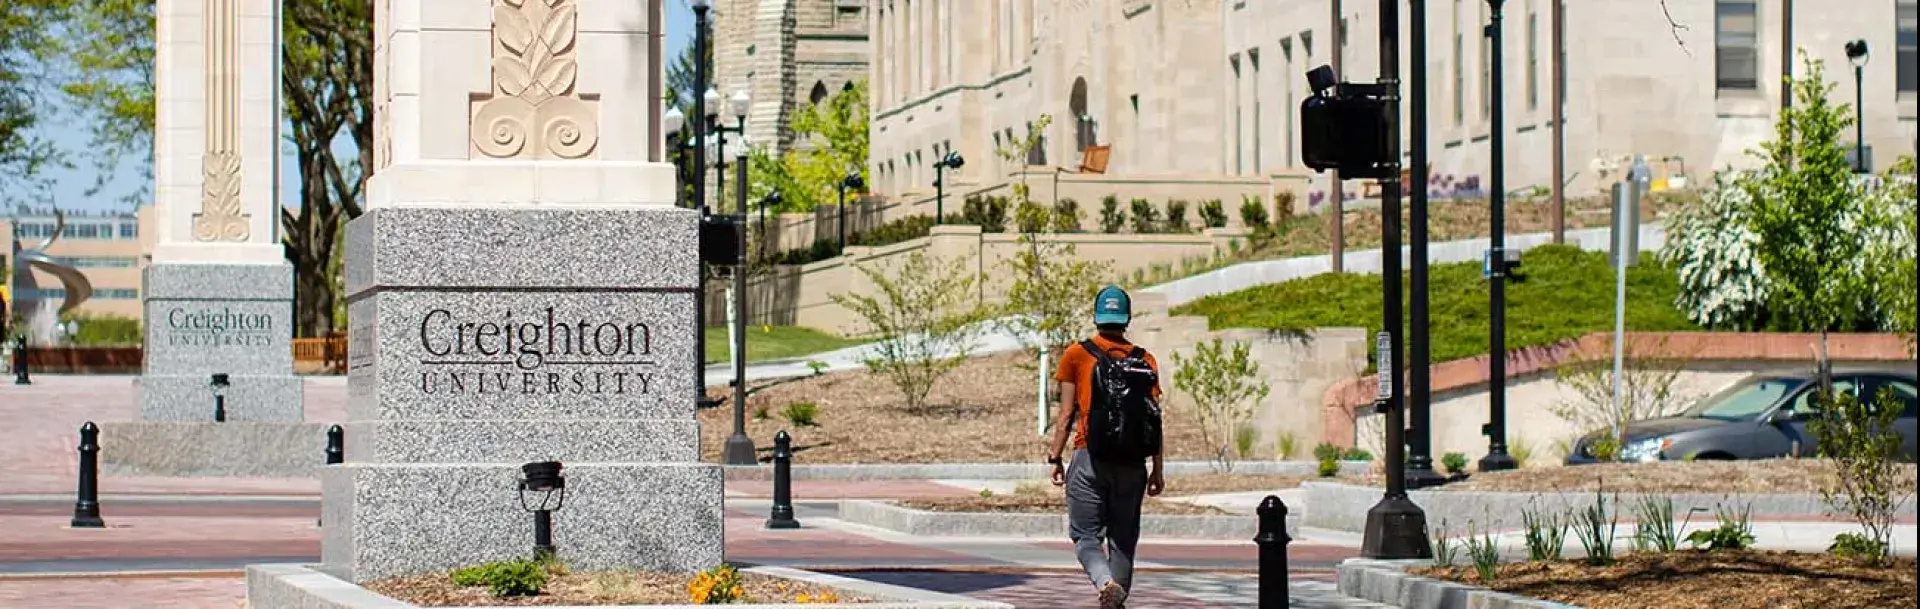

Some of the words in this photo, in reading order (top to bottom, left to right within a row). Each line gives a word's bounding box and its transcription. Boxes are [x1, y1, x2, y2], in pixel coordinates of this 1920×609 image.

[168, 307, 272, 335] Creighton
[421, 307, 650, 370] Creighton
[421, 372, 653, 394] UNIVERSITY
